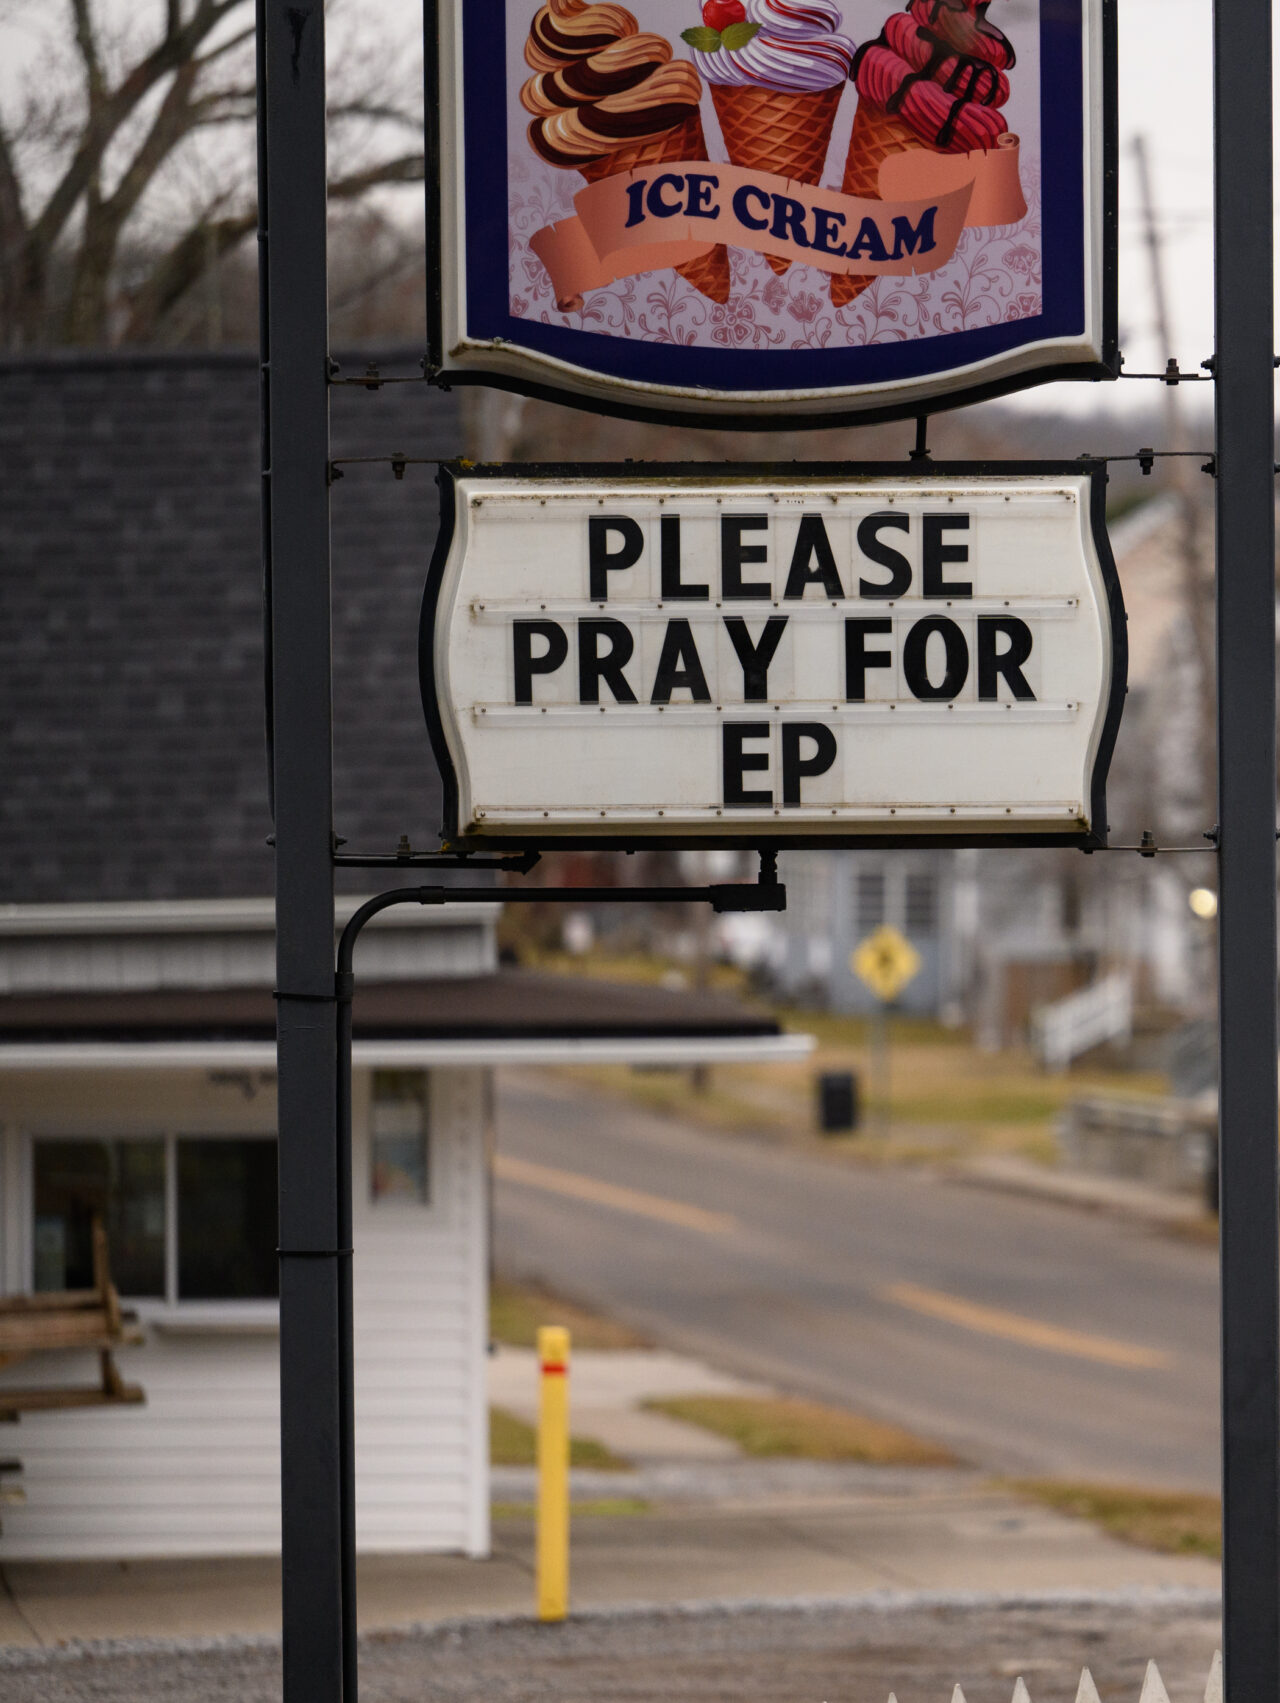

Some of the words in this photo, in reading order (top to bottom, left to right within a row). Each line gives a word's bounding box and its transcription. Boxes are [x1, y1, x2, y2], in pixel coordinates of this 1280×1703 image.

[625, 173, 720, 228] ICE
[732, 185, 938, 262] CREAM
[588, 510, 973, 602] PLEASE
[512, 615, 790, 706] PRAY
[844, 613, 1038, 703] FOR
[721, 720, 838, 809] EP
